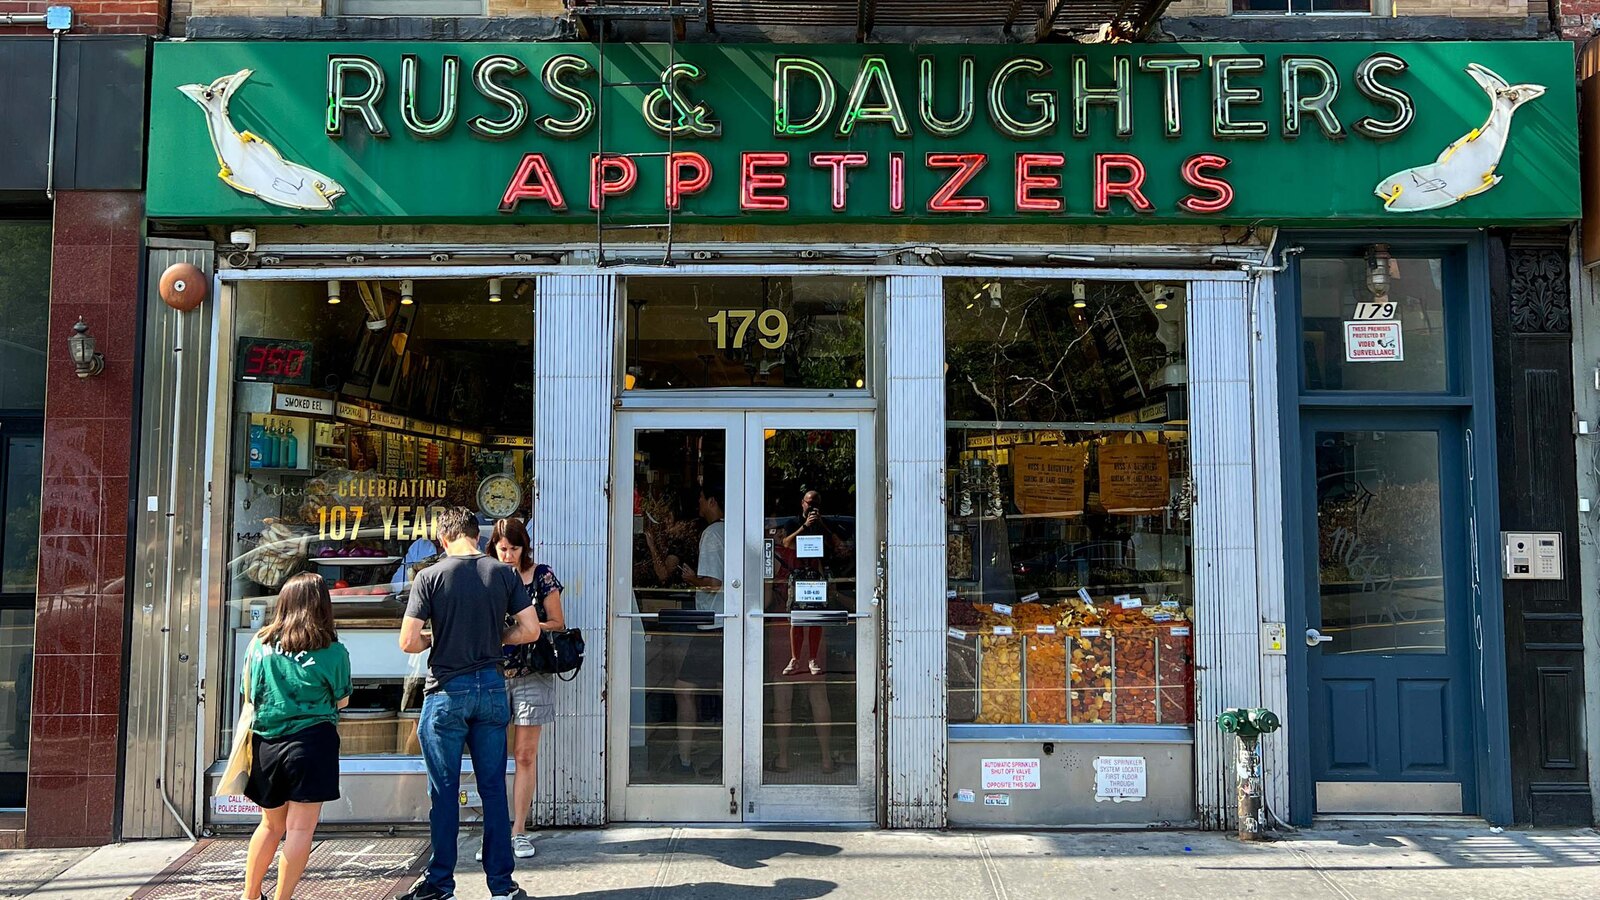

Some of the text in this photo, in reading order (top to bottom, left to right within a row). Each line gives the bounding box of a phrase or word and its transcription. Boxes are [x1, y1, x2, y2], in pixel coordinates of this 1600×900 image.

[325, 53, 1415, 138] RUSS & DAUGHTERS
[498, 152, 1235, 212] APPETIZERS
[1359, 303, 1393, 318] 179
[708, 309, 788, 349] 179
[284, 397, 322, 410] SMOKED EEL
[338, 479, 447, 498] CELEBRATING
[317, 505, 363, 540] 107
[228, 795, 242, 803] CALL
